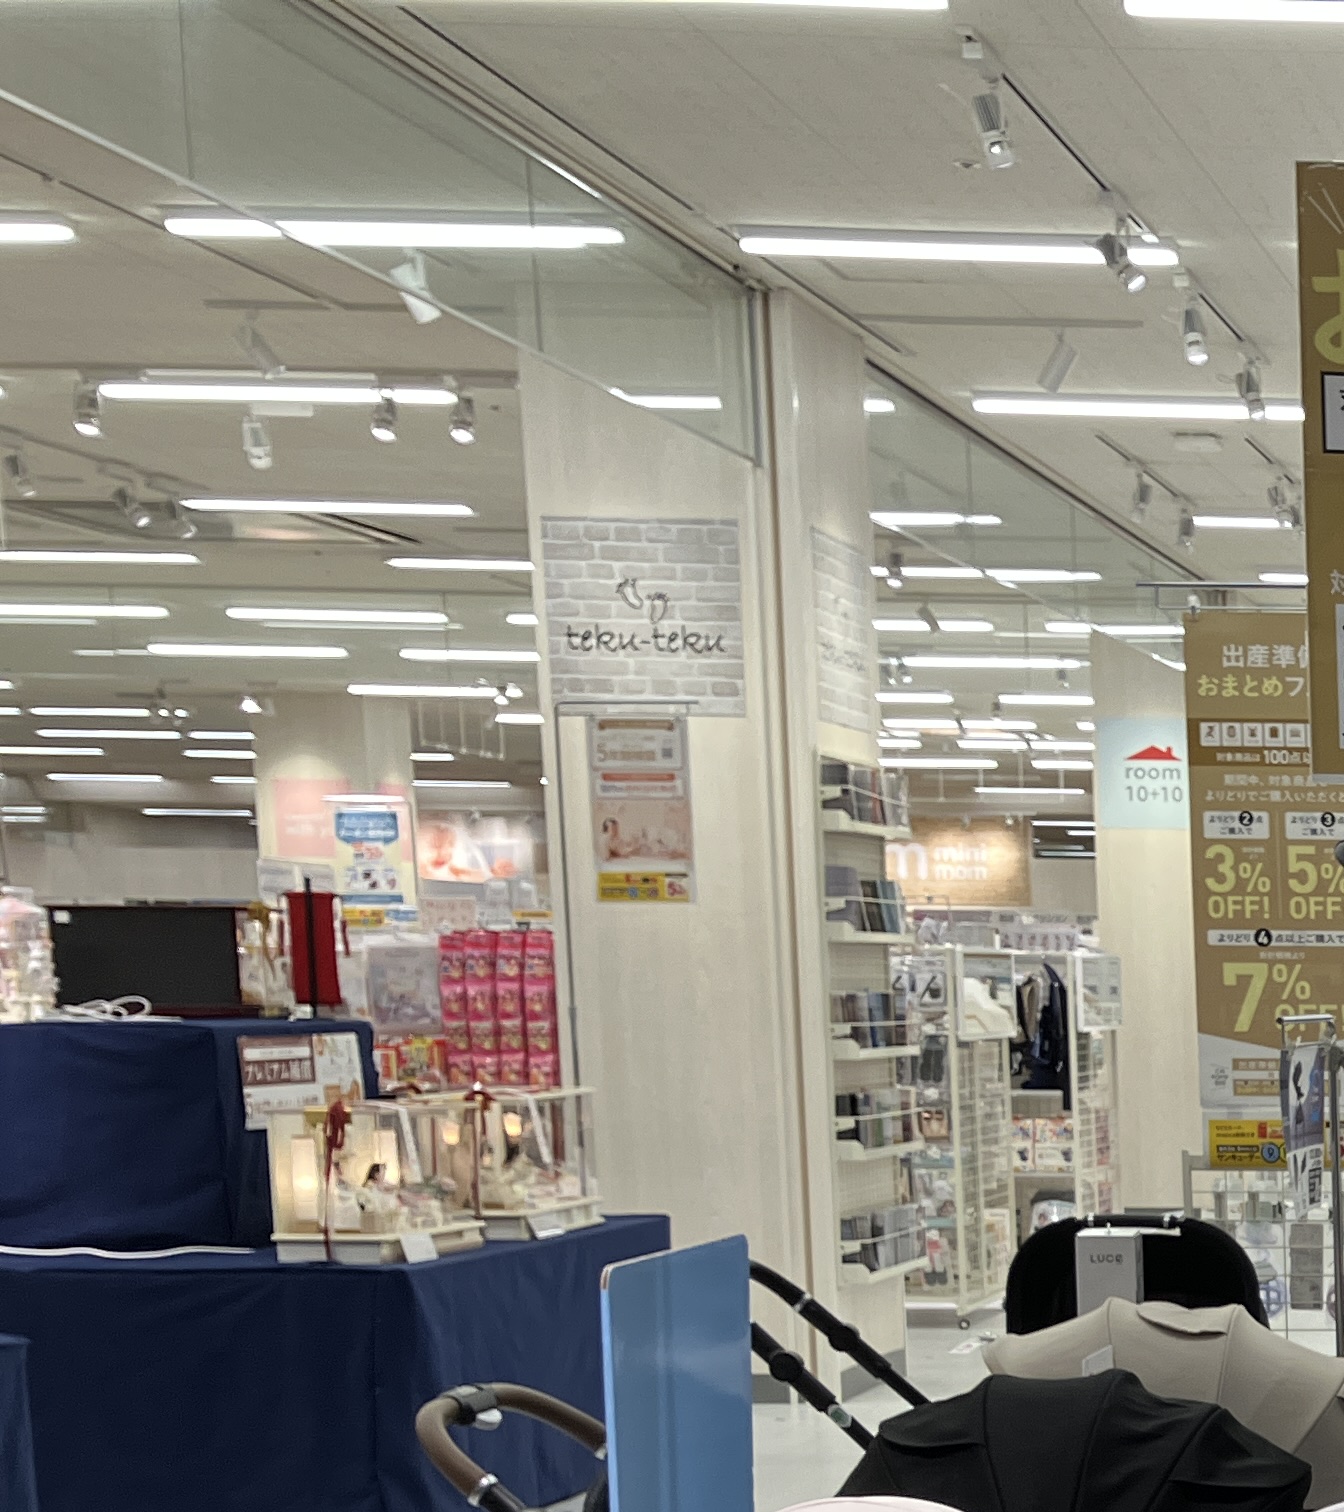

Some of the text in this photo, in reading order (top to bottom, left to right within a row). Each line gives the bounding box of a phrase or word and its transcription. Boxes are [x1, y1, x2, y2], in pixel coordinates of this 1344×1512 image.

[564, 624, 726, 654] teku-teku
[1197, 675, 1307, 697] おまとめフ
[1125, 767, 1180, 780] room
[1125, 787, 1182, 802] 10+10
[1208, 896, 1270, 919] OFF!
